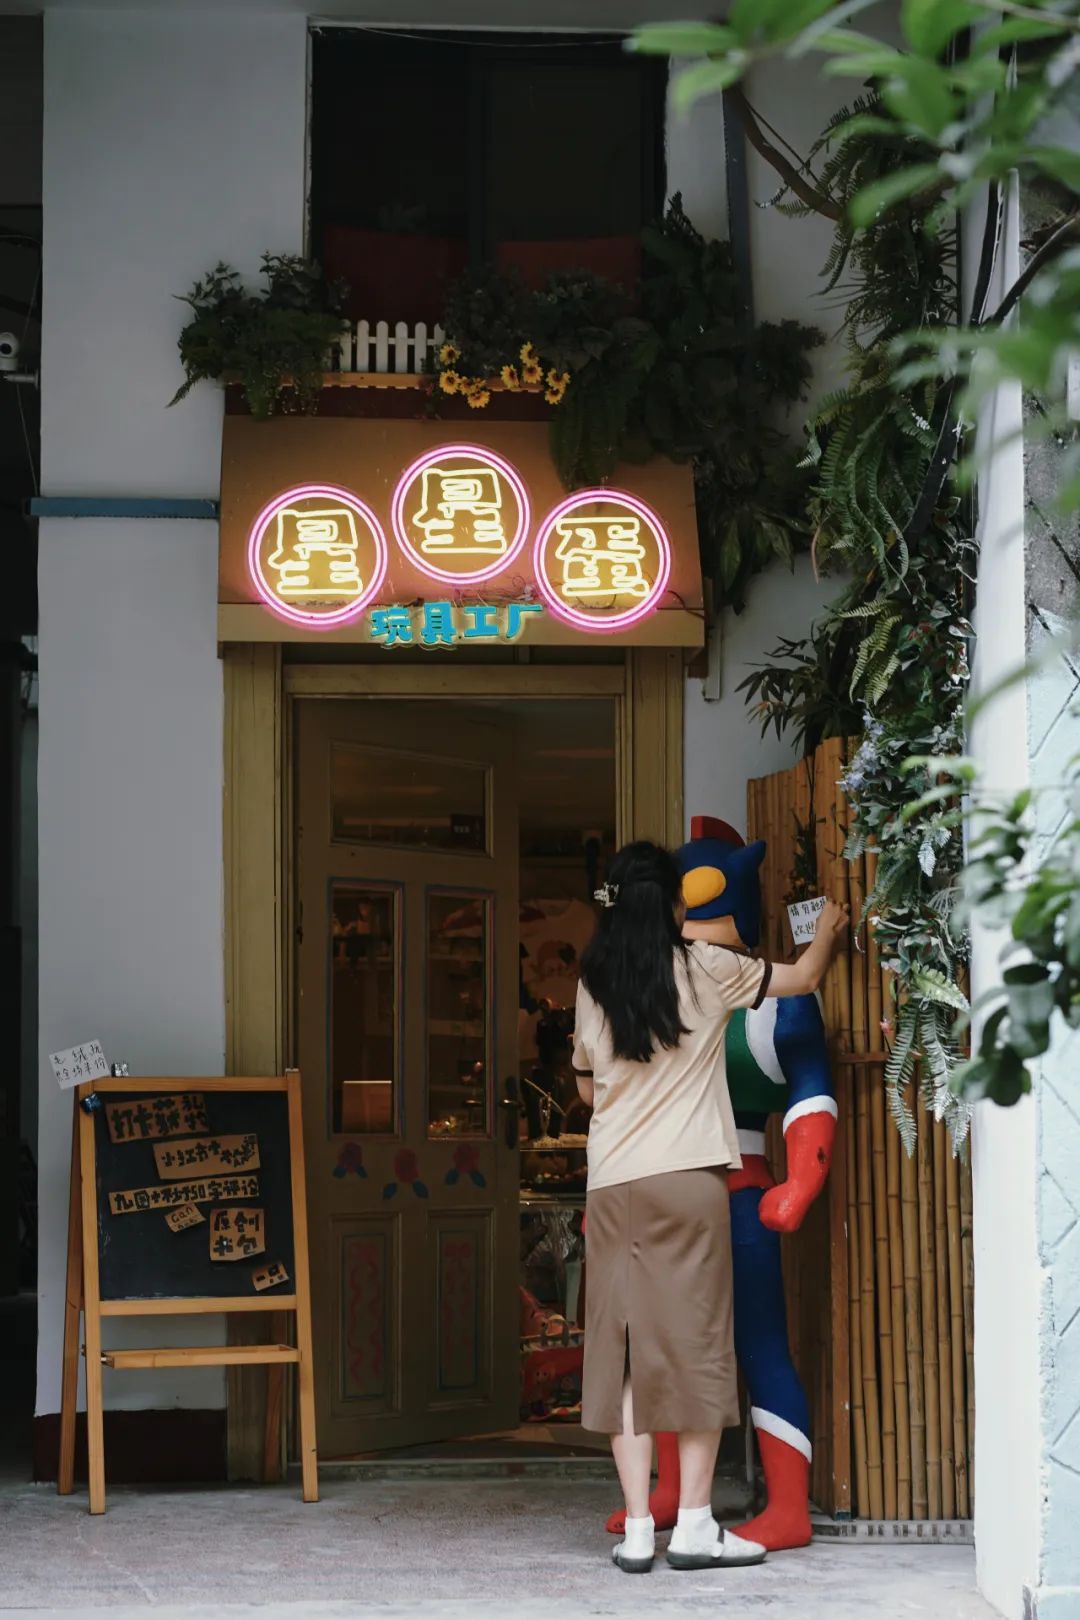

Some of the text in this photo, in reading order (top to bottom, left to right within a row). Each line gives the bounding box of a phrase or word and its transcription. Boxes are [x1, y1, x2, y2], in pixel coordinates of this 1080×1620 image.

[267, 467, 652, 597] 星星蛋
[369, 601, 543, 647] 玩具工厂
